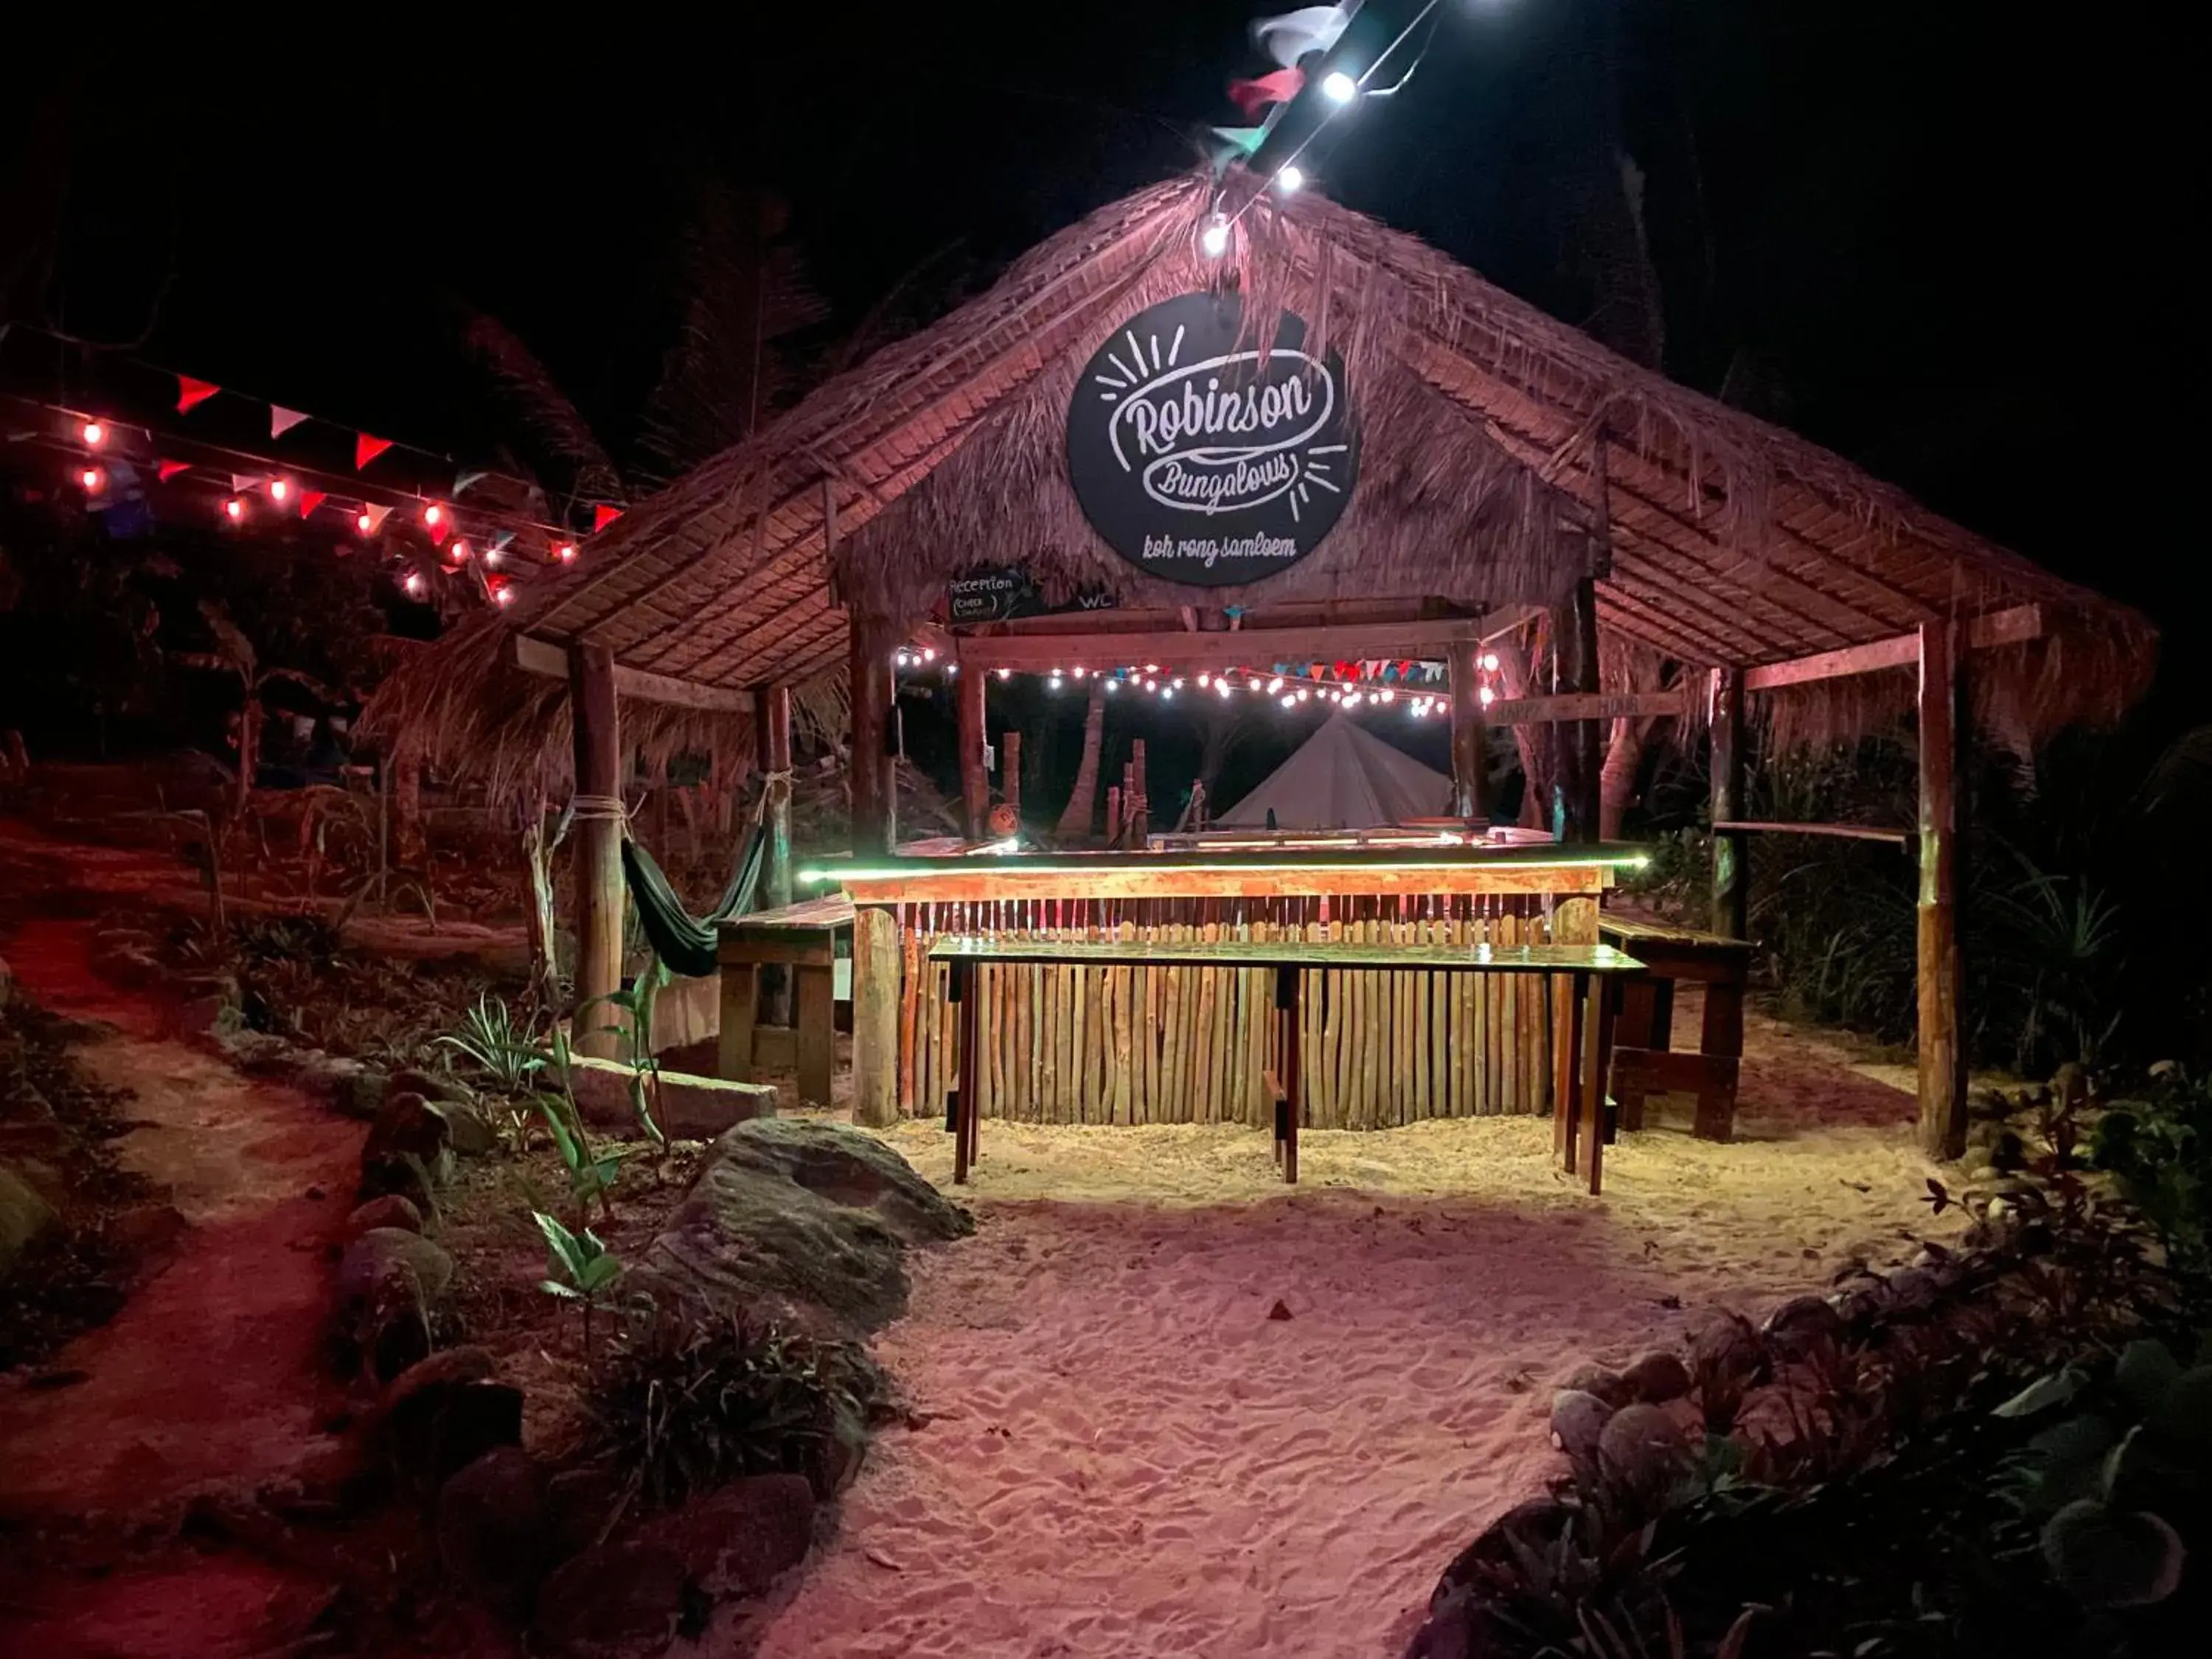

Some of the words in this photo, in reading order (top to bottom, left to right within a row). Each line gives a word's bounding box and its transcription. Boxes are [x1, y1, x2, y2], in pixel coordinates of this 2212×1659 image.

[1127, 376, 1311, 455] Robinson
[1158, 453, 1291, 515] Bungalows
[1142, 535, 1175, 560] koh
[1177, 539, 1219, 568] rong
[1220, 531, 1296, 557] samloem
[1079, 594, 1112, 609] WC
